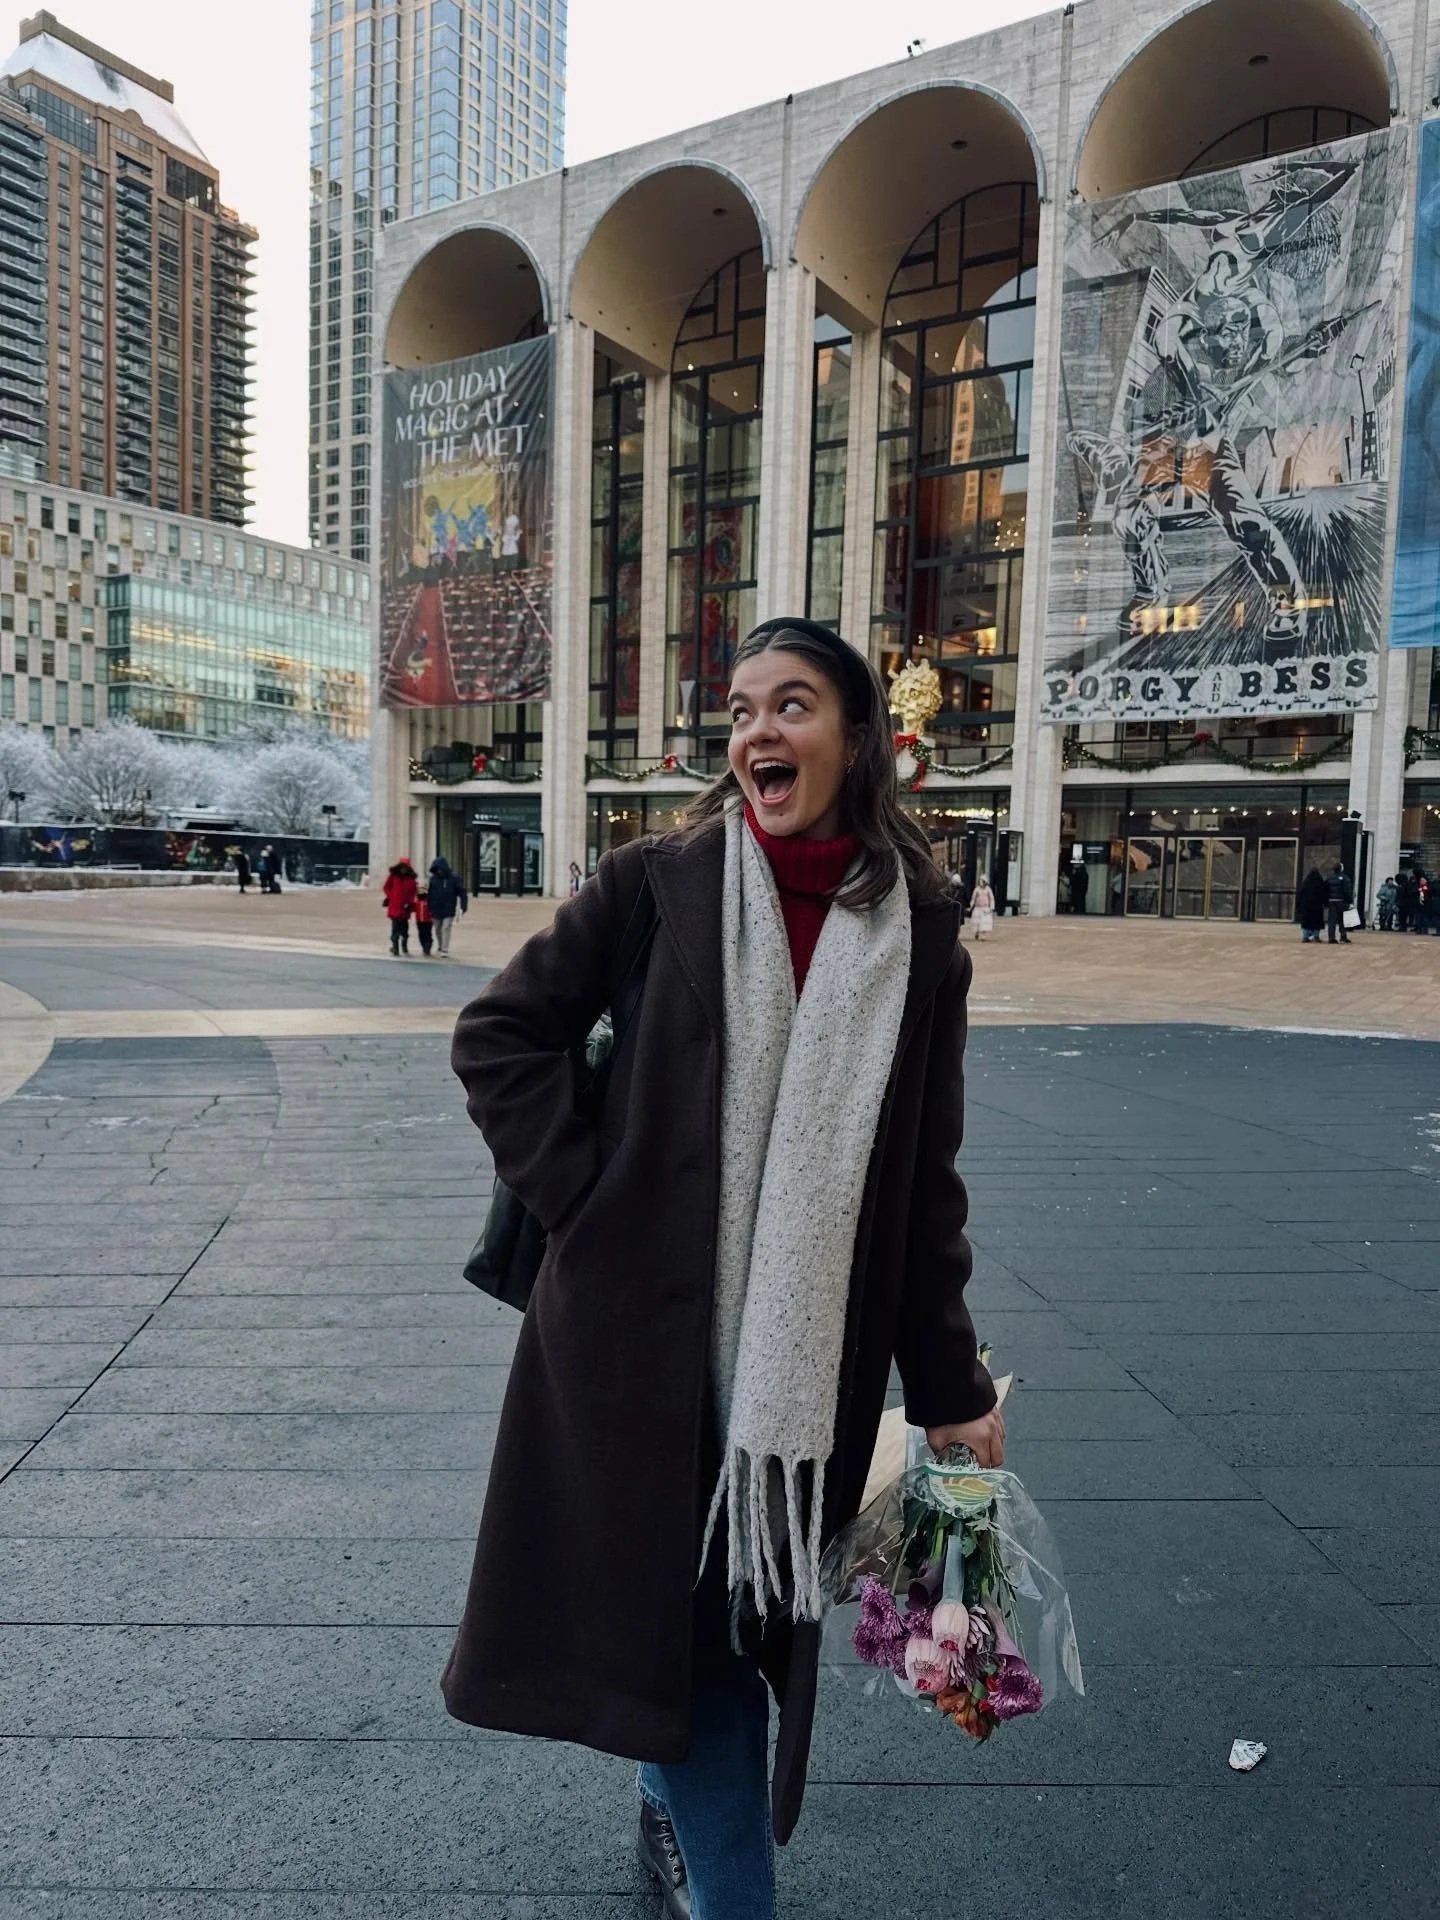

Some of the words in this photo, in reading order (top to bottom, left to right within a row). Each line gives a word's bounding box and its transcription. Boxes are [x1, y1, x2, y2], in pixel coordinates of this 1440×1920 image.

[410, 363, 515, 410] HOLIDAY
[395, 403, 469, 444] MAGIC
[474, 393, 509, 425] AT
[416, 434, 463, 469] THE
[469, 423, 529, 460] MET
[1047, 675, 1200, 706] PORGY
[1210, 671, 1223, 703] AND
[1238, 658, 1368, 698] BESS
